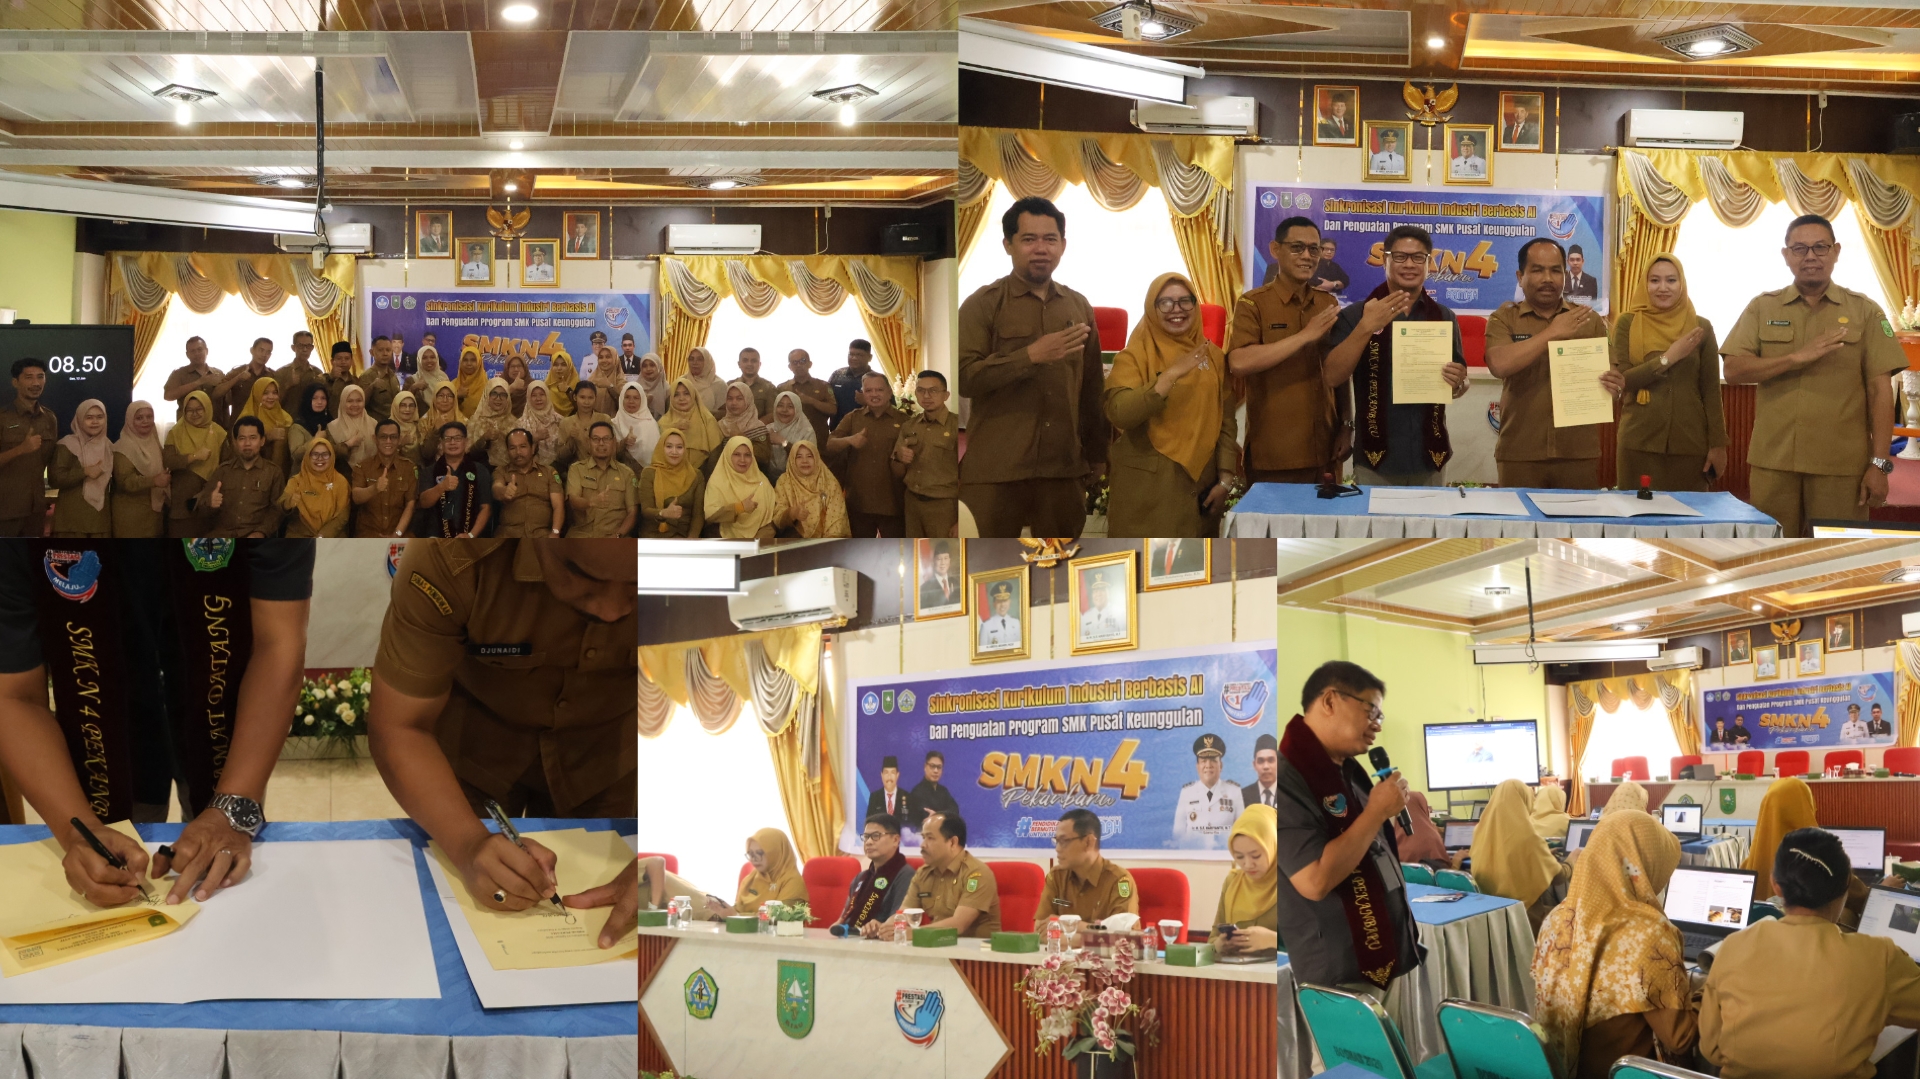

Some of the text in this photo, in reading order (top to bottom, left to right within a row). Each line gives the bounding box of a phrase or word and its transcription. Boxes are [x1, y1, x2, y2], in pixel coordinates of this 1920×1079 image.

[1324, 199, 1386, 214] Sinkronisasi
[1388, 200, 1439, 215] Kurikulum
[1441, 202, 1480, 216] Industri
[1482, 204, 1525, 218] Berbasis
[1527, 205, 1537, 218] AI
[1324, 220, 1341, 231] Dan
[1343, 221, 1391, 233] Penguatan
[1435, 223, 1454, 234] SMK
[1456, 223, 1481, 235] Pusat
[1483, 224, 1536, 237] Keunggulan
[1366, 240, 1499, 279] SKN 4
[425, 300, 596, 313] Sinkronisasi Kurikulum Industri Berbasis AI
[426, 317, 596, 328] Dan Penguatan Program SMK Pusat Keunggulan
[461, 331, 567, 359] SMKN 4
[48, 356, 107, 373] 08.50
[203, 594, 232, 705] DATANG
[929, 674, 1204, 714] Sinkronisasi Kurikulum Industri Berbasis AI
[79, 704, 101, 719] 4
[929, 706, 1203, 740] Dan Penguatan Program SMK Pusat Keunggulan
[1759, 706, 1831, 729] SMKN 4
[206, 708, 229, 782] AMAT
[80, 723, 110, 817] PEKANB
[977, 738, 1150, 801] SMKN 4
[1001, 784, 1117, 809] Pekanbaru
[1352, 876, 1383, 950] PEKANBARU
